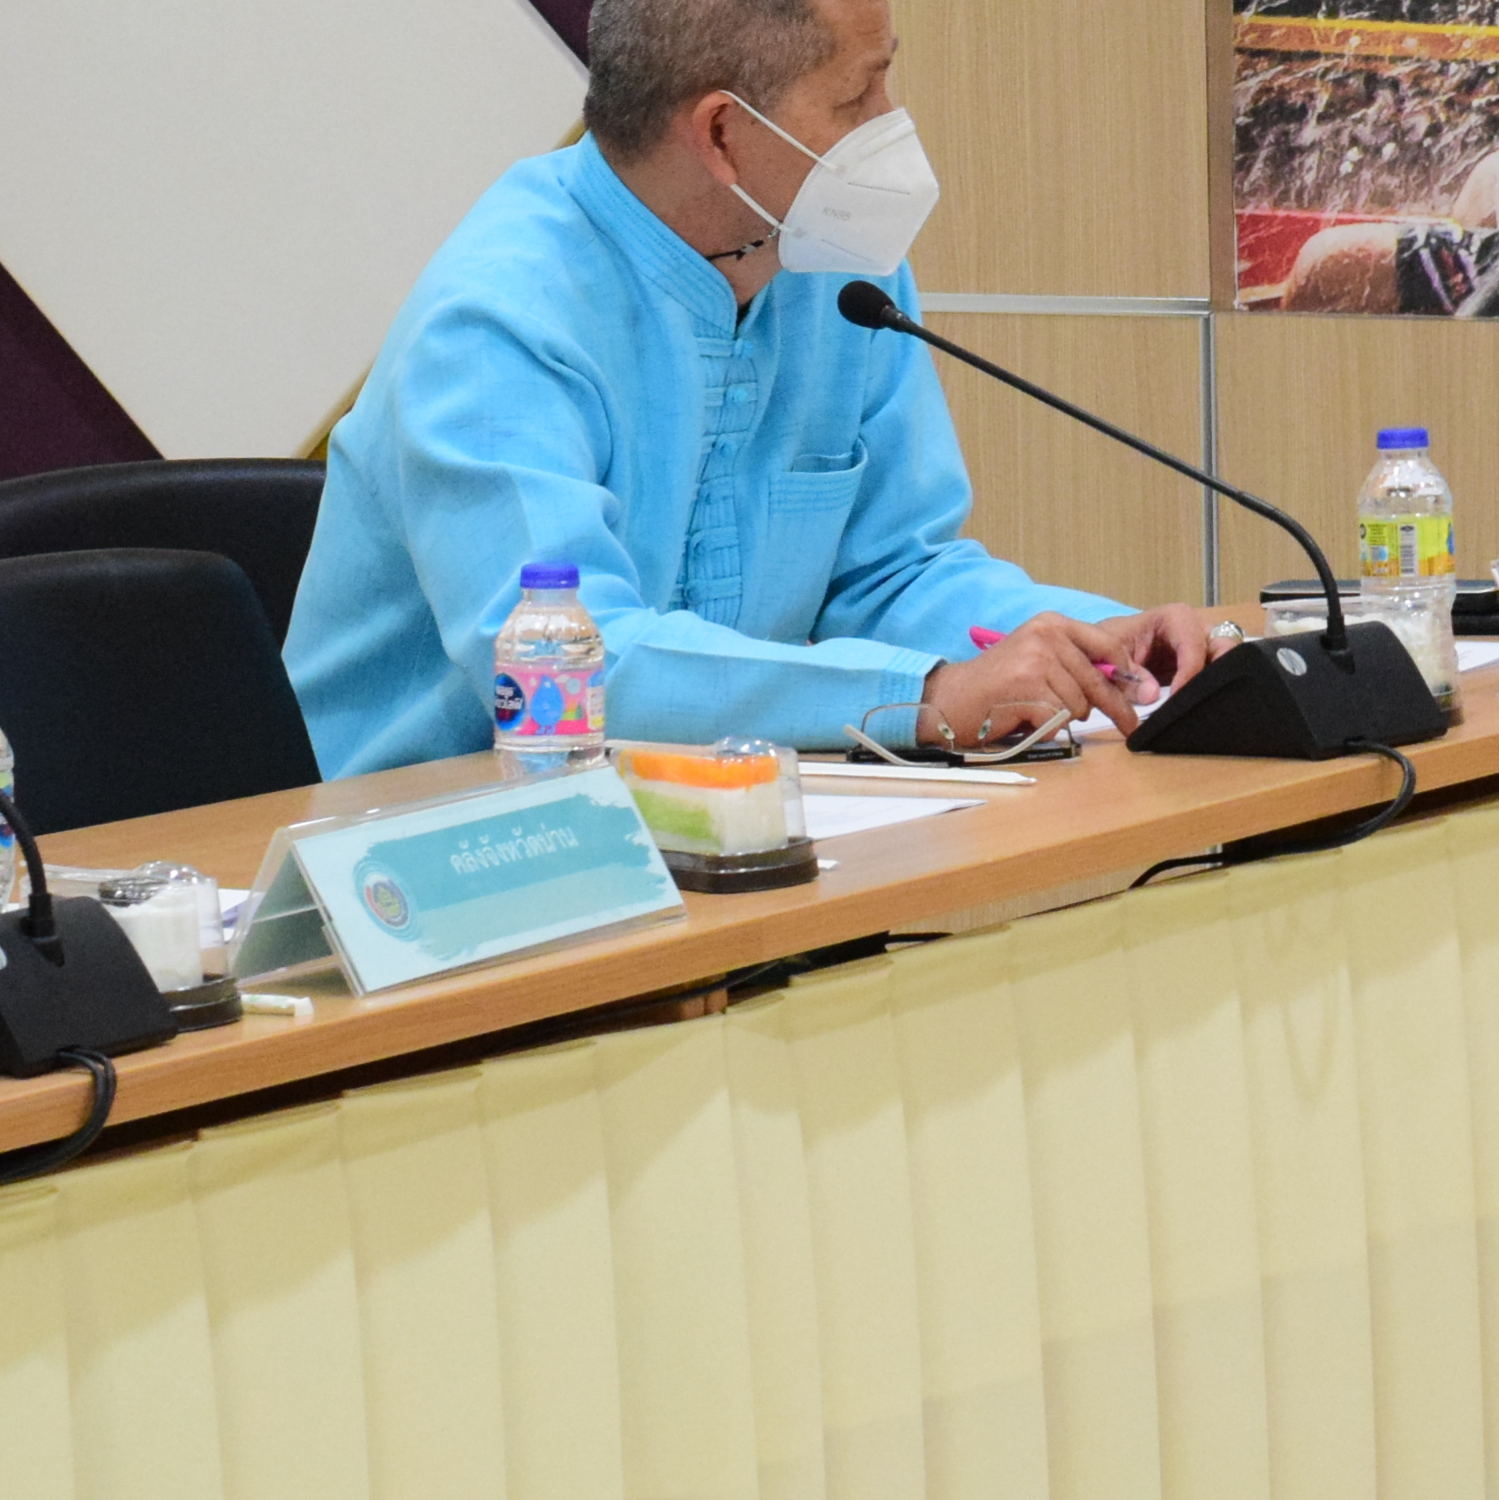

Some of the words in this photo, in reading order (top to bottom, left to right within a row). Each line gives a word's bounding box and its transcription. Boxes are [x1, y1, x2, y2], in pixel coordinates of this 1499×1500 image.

[449, 821, 580, 875] คลังจังหวัดน่าน
